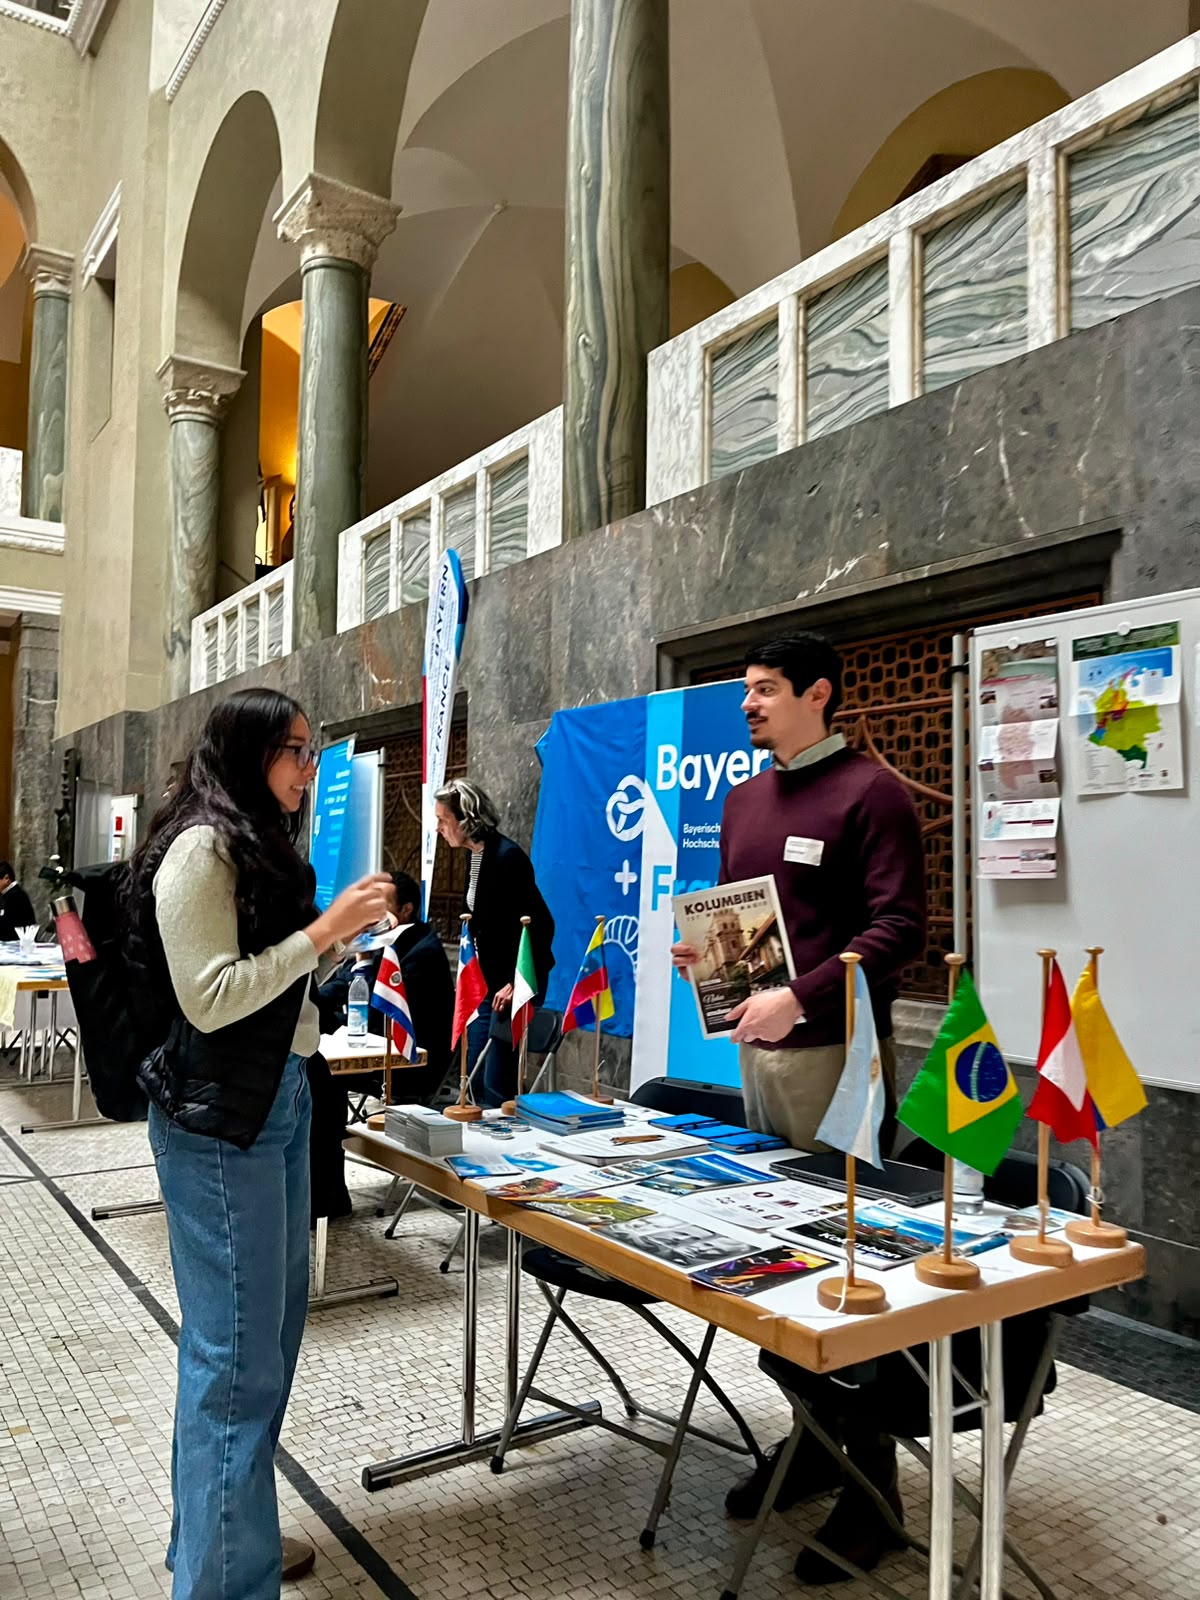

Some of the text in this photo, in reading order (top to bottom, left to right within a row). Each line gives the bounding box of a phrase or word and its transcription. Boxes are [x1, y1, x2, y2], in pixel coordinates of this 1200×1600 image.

[434, 564, 449, 656] BAYERN
[435, 661, 451, 753] FRANCE
[656, 744, 769, 800] Bayer
[683, 822, 721, 835] Bayerisch
[682, 838, 720, 849] Hochschu
[684, 888, 766, 916] KOLUMBIEN
[818, 1232, 902, 1259] Kolmbien
